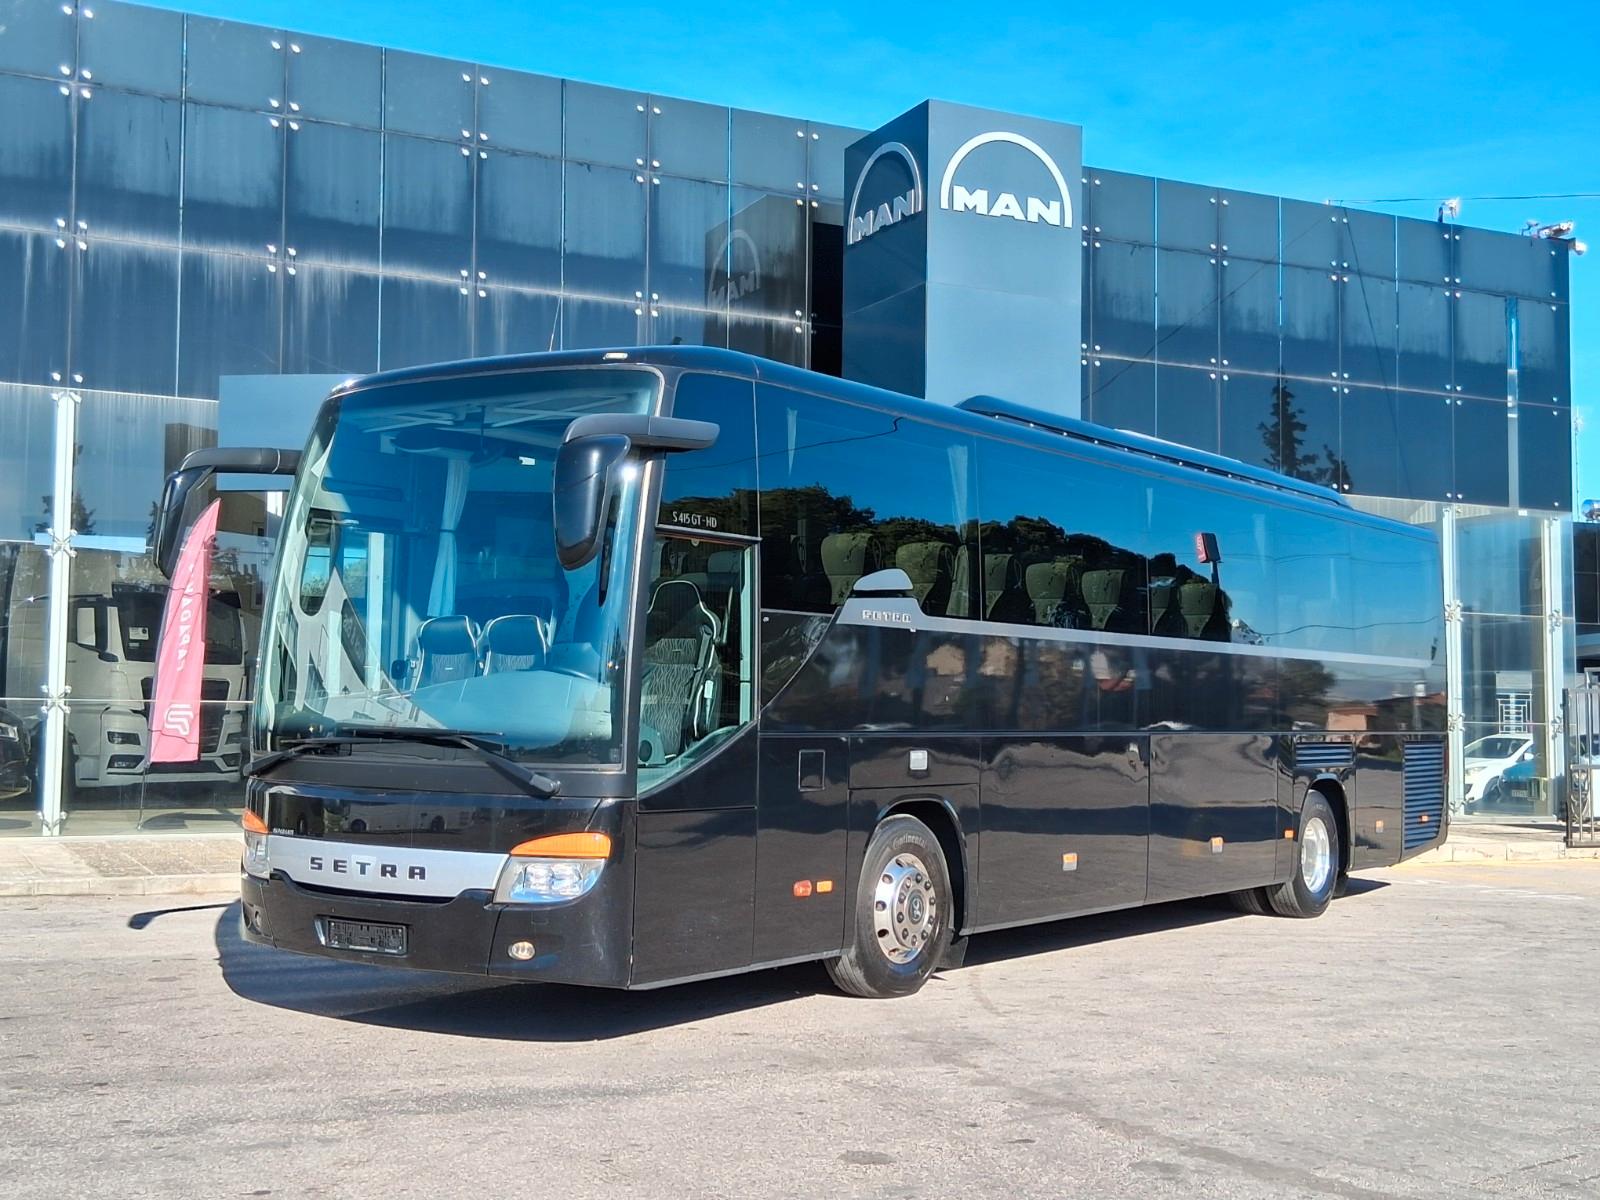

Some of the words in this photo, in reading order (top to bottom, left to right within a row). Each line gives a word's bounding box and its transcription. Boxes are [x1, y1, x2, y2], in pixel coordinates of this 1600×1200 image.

[853, 188, 915, 242] MAN
[952, 185, 1061, 226] MAN
[672, 511, 678, 523] S
[678, 512, 691, 525] 415
[892, 832, 928, 849] Continental
[310, 856, 426, 880] SETRA
